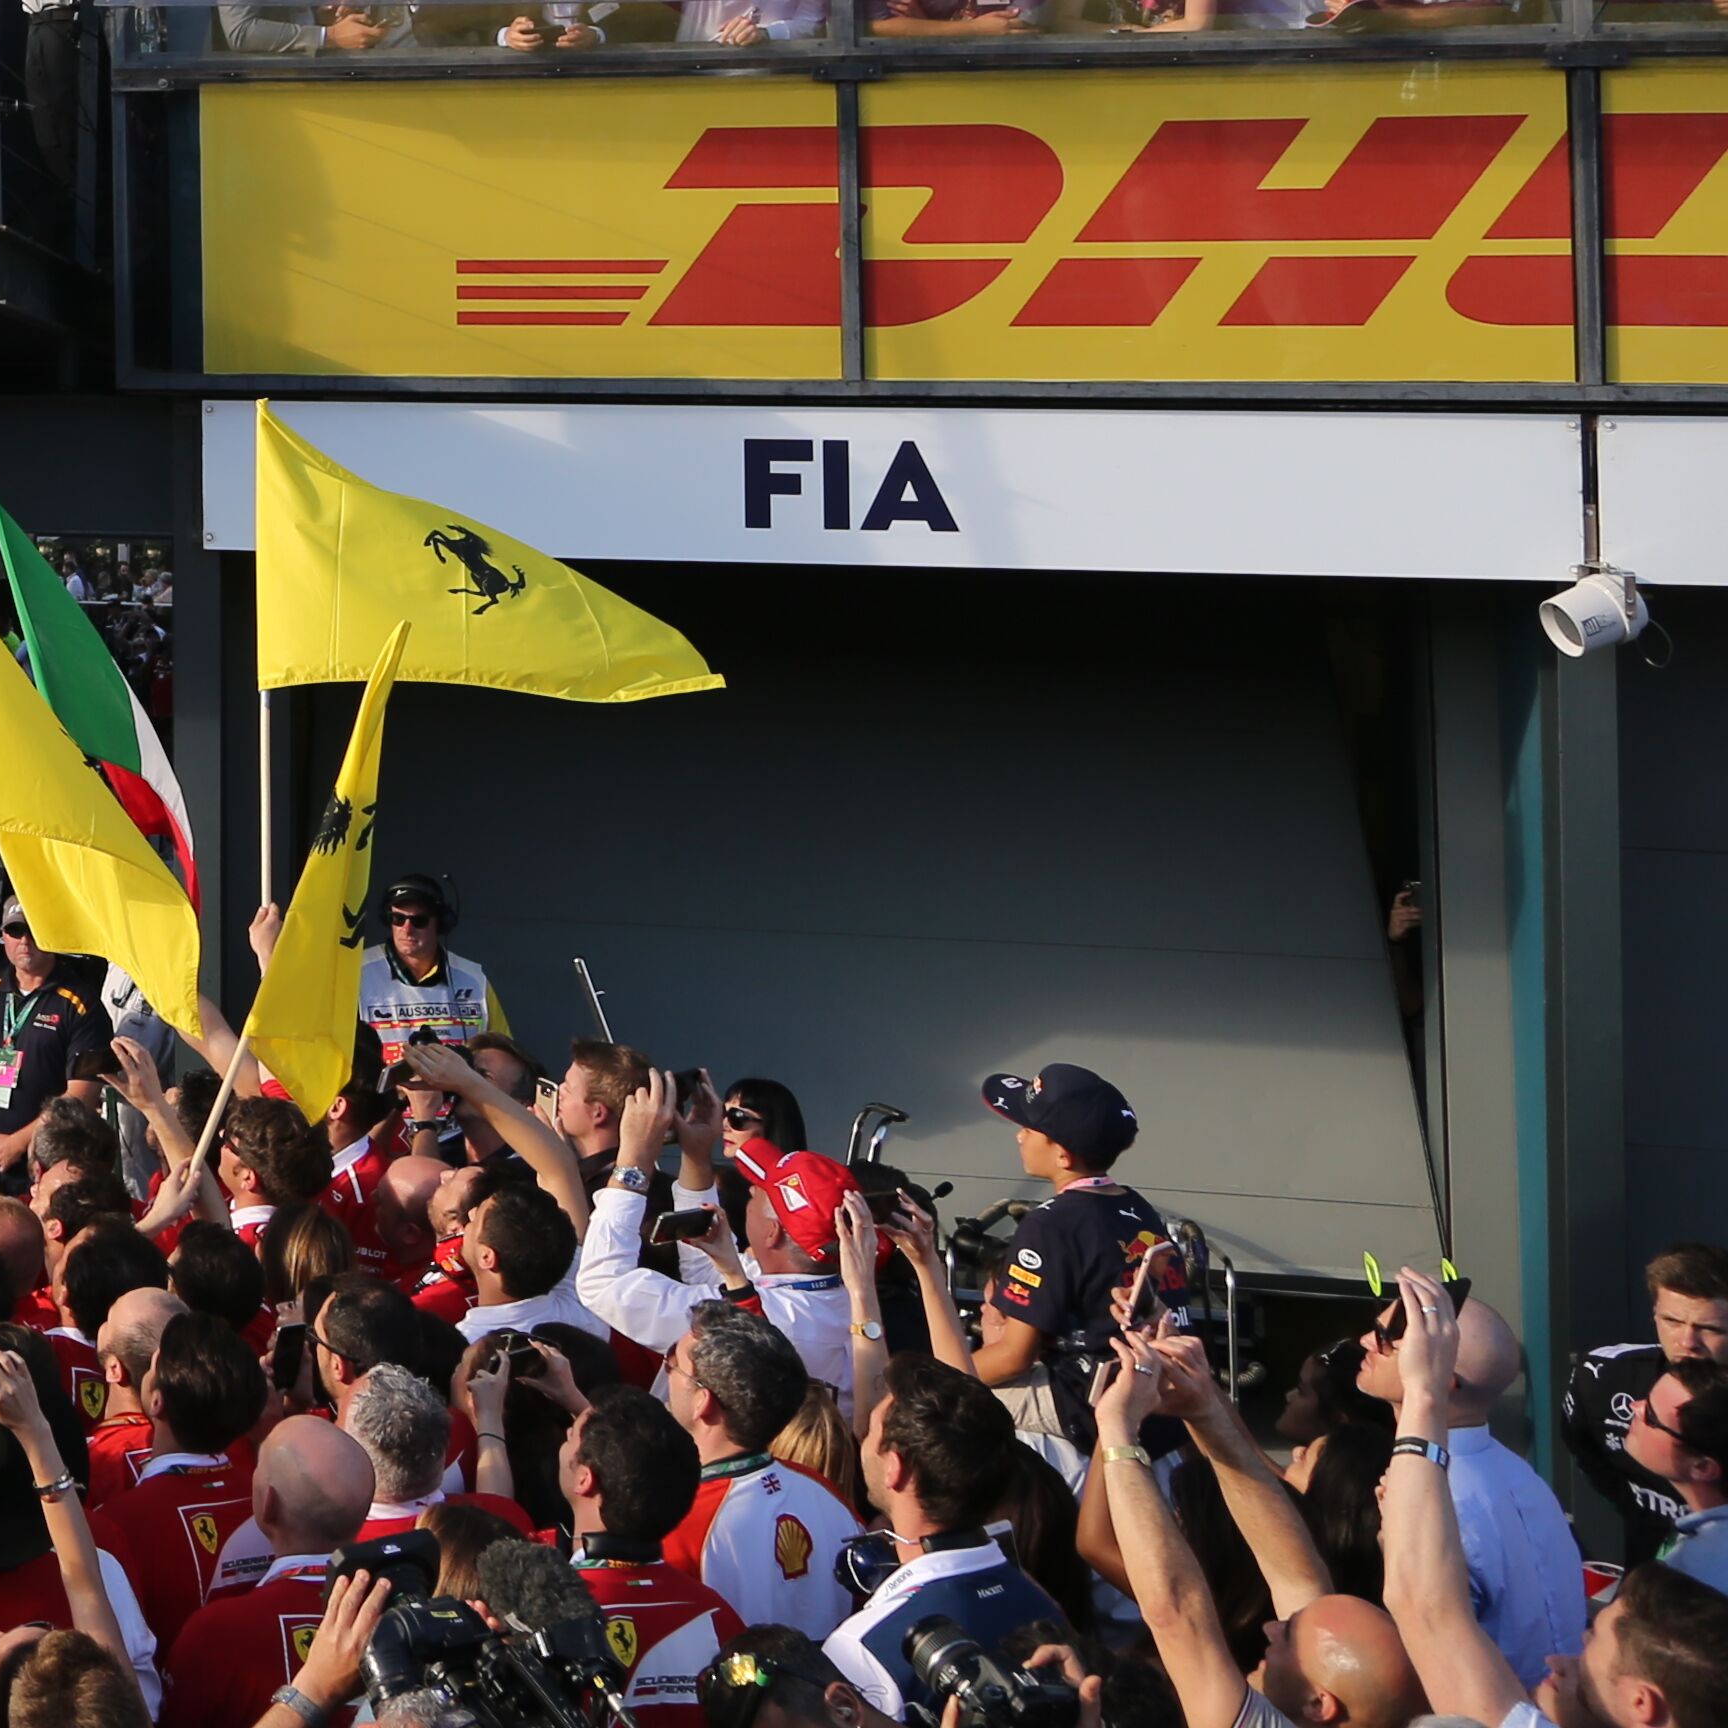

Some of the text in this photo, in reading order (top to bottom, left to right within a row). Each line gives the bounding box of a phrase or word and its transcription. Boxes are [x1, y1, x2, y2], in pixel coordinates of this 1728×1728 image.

[647, 113, 1728, 328] DHL
[743, 439, 960, 534] FIA
[398, 1006, 449, 1018] AUS3054
